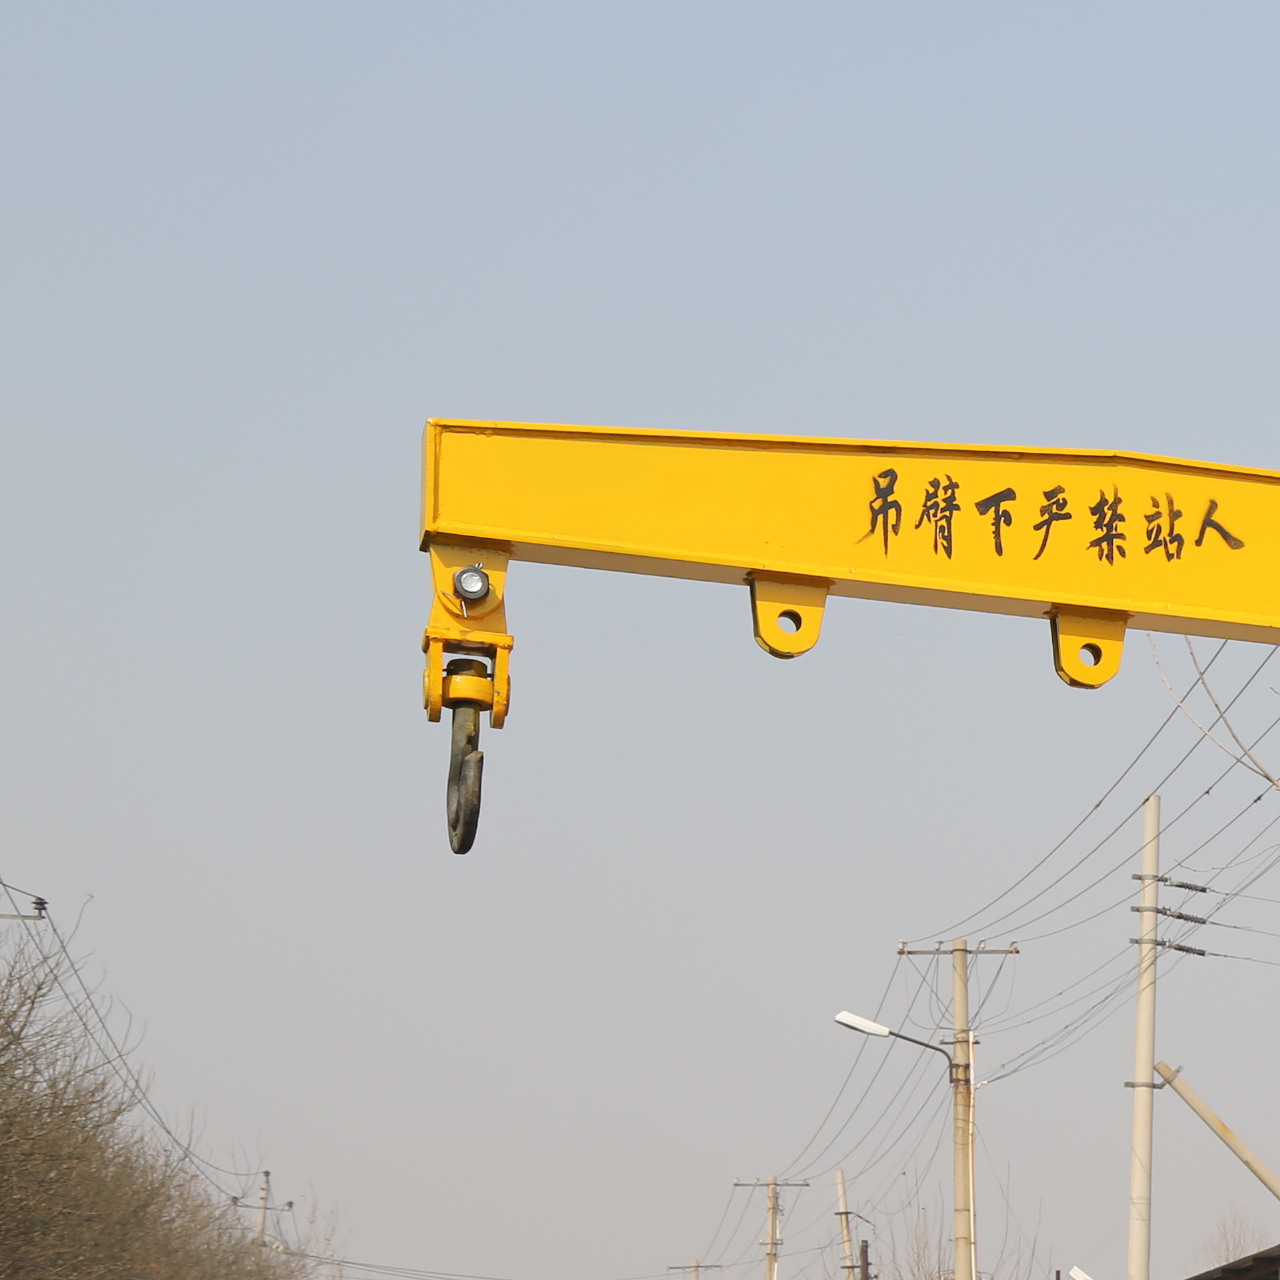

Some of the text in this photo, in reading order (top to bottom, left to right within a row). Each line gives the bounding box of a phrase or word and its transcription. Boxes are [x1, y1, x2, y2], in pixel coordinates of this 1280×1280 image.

[853, 468, 1245, 566] 吊臂下严禁站人
